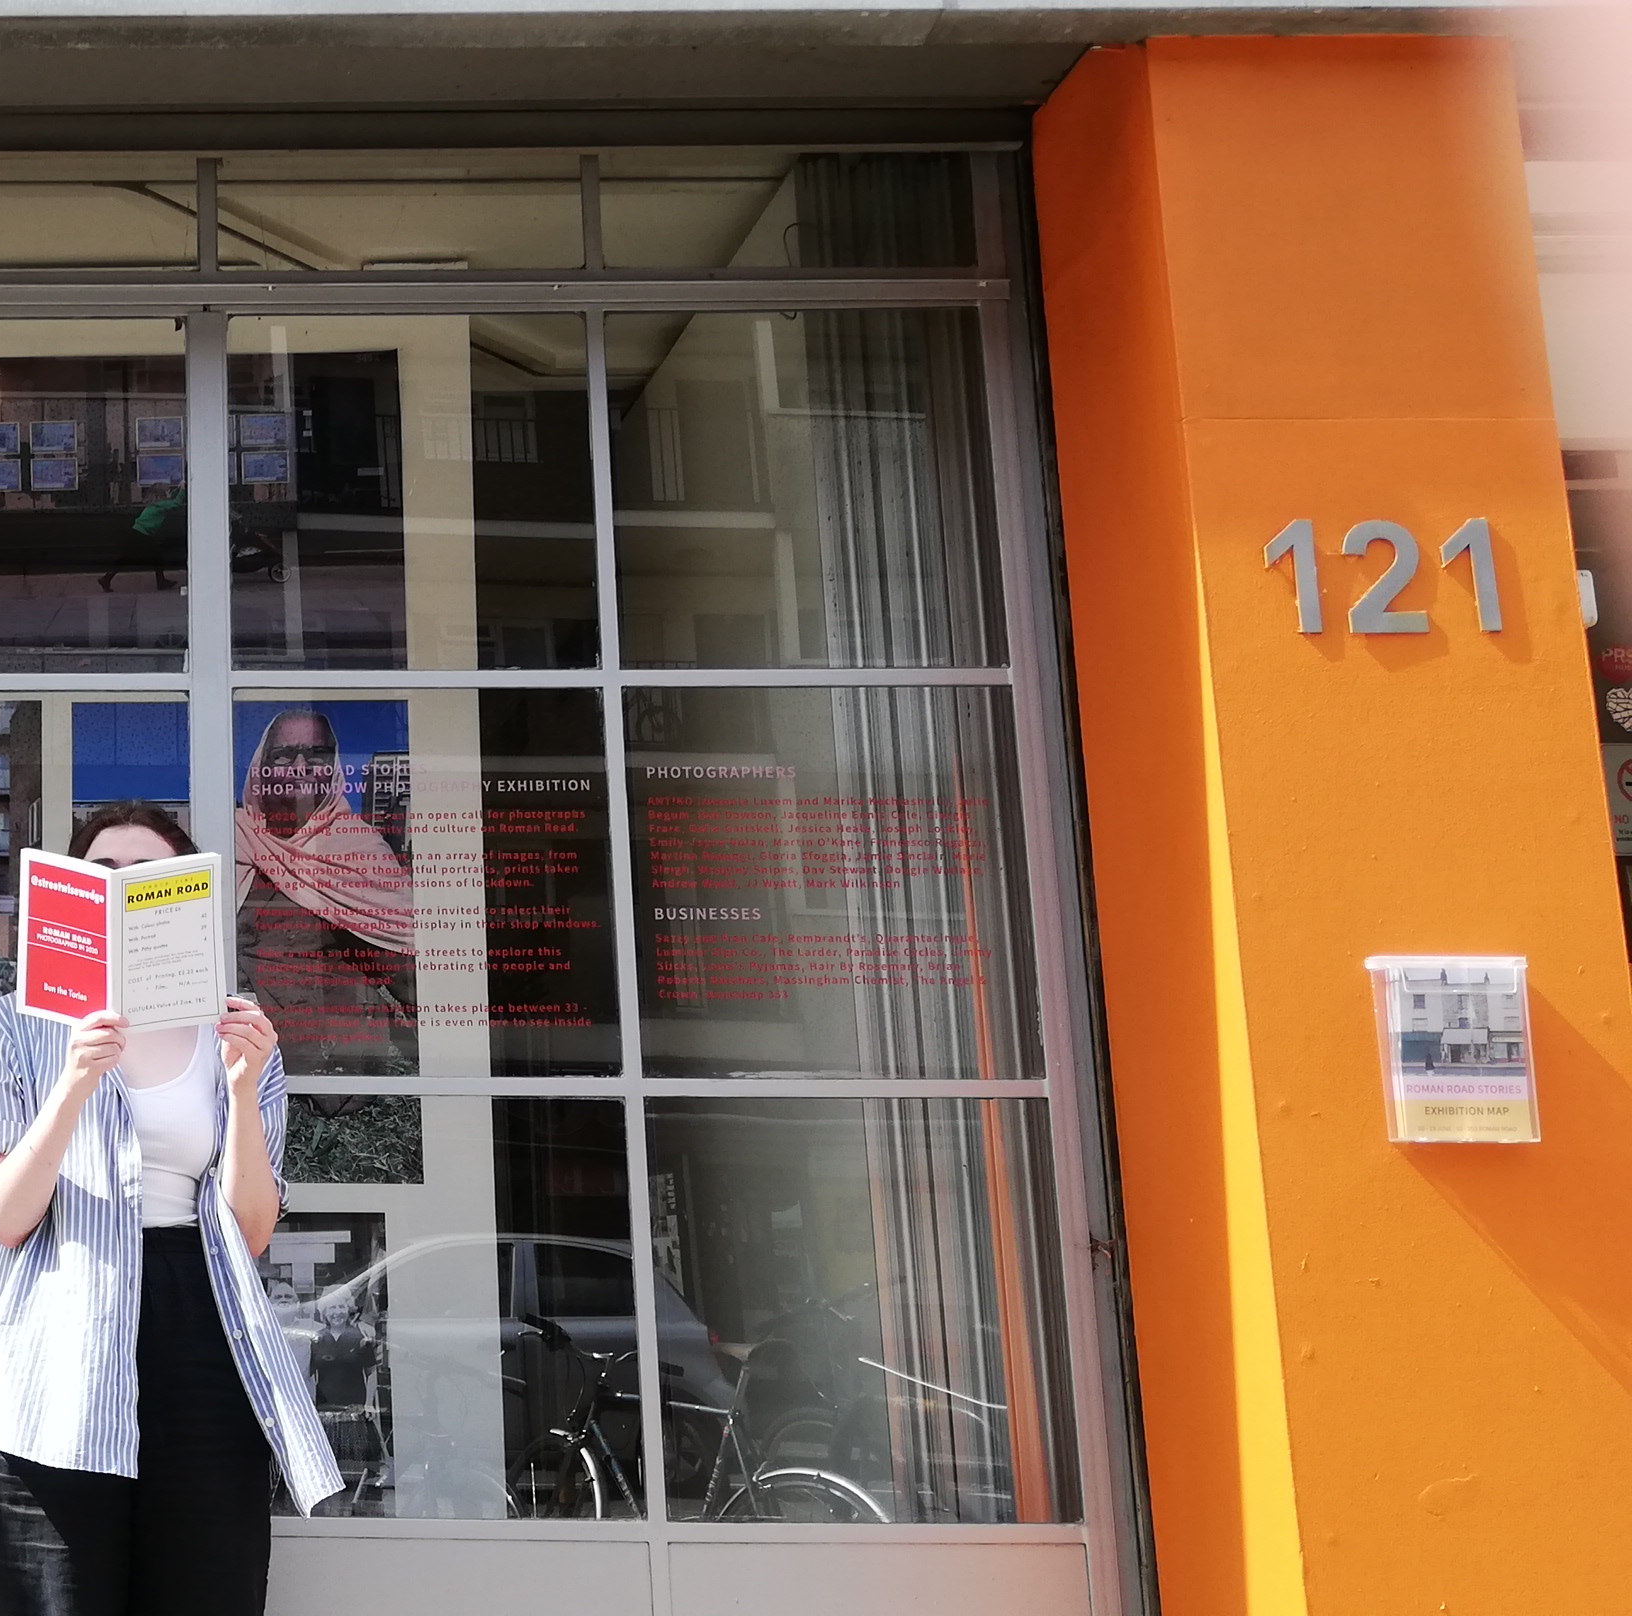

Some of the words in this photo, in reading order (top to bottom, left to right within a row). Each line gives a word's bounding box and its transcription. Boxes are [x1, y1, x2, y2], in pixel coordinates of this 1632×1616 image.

[1263, 517, 1502, 635] 121
[251, 766, 307, 778] ROMAN
[313, 764, 355, 776] ROAD
[646, 766, 796, 779] PHOTOGRAPHERS
[251, 783, 294, 796] SHOP
[299, 782, 368, 795] WINDOW
[497, 779, 591, 792] EXHIBITION
[753, 797, 792, 806] Luxem
[797, 796, 819, 806] and
[824, 797, 865, 806] Marika
[429, 811, 457, 821] open
[461, 810, 484, 820] call
[487, 809, 505, 819] for
[509, 808, 586, 821] photographs
[781, 810, 848, 821] Jacqueline
[407, 825, 428, 834] and
[433, 824, 477, 833] culture
[499, 823, 542, 833] Roman
[787, 824, 832, 834] Jessica
[773, 838, 813, 847] Martin
[254, 852, 285, 862] Local
[289, 852, 378, 863] photographers
[411, 851, 423, 861] in
[446, 852, 477, 862] array
[482, 850, 494, 860] of
[497, 850, 545, 862] images,
[548, 849, 577, 860] from
[760, 852, 797, 860] Gloria
[291, 866, 349, 876] snapshots
[356, 866, 369, 875] to
[372, 864, 437, 876] thoughtful
[441, 864, 499, 877] portraits,
[503, 864, 541, 875] prints
[543, 864, 579, 873] taken
[753, 866, 800, 876] Snipes,
[803, 865, 825, 875] Dav
[31, 875, 105, 905] @streetwisewedge
[284, 881, 306, 891] ago
[310, 879, 332, 889] and
[378, 878, 452, 890] impressions
[456, 877, 468, 888] of
[472, 877, 534, 888] lockdown.
[763, 879, 802, 890] Wyatt,
[806, 879, 836, 889] Mark
[127, 888, 172, 904] ROMAN
[177, 882, 209, 895] ROAD
[154, 907, 173, 916] PRICE
[333, 907, 400, 916] businesses
[403, 907, 433, 916] were
[437, 906, 480, 915] invited
[486, 906, 496, 915] to
[500, 905, 538, 915] select
[540, 905, 571, 915] their
[654, 907, 762, 921] BUSINESSES
[395, 920, 408, 929] to
[412, 919, 456, 931] display
[460, 919, 472, 929] in
[476, 919, 506, 929] their
[510, 919, 539, 931] shop
[36, 933, 78, 950] PHOTOGRAPHED
[42, 926, 71, 940] ROMAN
[72, 933, 92, 946] ROAD
[328, 948, 350, 958] and
[354, 948, 381, 958] take
[400, 947, 421, 957] the
[424, 948, 468, 957] streets
[471, 948, 484, 957] to
[487, 947, 534, 958] explore
[537, 947, 562, 956] this
[771, 947, 792, 957] The
[798, 947, 842, 958] Larder,
[479, 961, 499, 971] the
[502, 962, 545, 972] people
[548, 961, 571, 971] and
[810, 961, 835, 971] Hair
[840, 962, 854, 973] By
[928, 962, 960, 971] Brian
[774, 975, 850, 988] Massingham
[854, 975, 910, 987] Chemist,
[57, 985, 68, 997] the
[69, 987, 88, 1003] Tories
[128, 1005, 156, 1014] CULTURAL
[434, 1004, 468, 1014] takes
[472, 1004, 504, 1015] place
[507, 1003, 561, 1013] between
[565, 1003, 579, 1013] 33
[431, 1017, 441, 1027] is
[445, 1019, 474, 1028] even
[478, 1018, 511, 1028] more
[514, 1017, 526, 1027] to
[529, 1018, 551, 1027] see
[554, 1017, 592, 1027] inside
[1406, 1084, 1445, 1095] ROMAN
[1447, 1084, 1476, 1095] ROAD
[1477, 1084, 1522, 1095] STORIES
[1424, 1106, 1485, 1116] EXHIBITION
[1486, 1106, 1510, 1116] MAP
